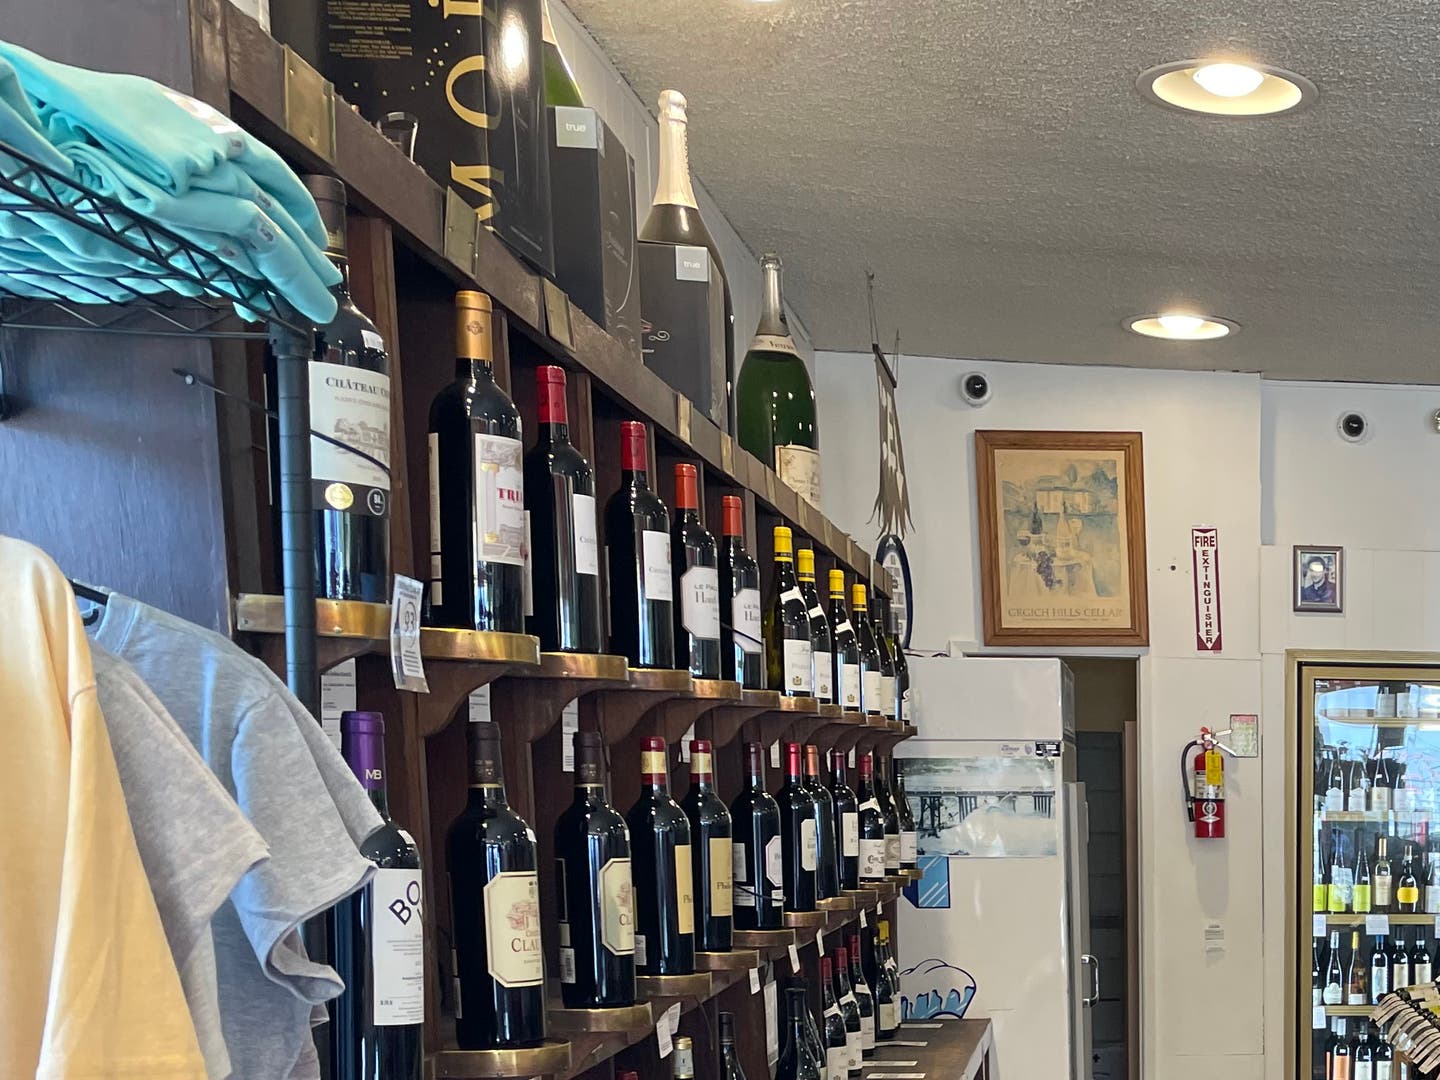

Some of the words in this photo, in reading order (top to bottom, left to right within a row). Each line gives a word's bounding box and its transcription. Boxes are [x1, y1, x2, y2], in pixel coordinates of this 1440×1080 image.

[566, 122, 586, 132] true
[684, 261, 701, 269] true
[1194, 536, 1215, 548] FIRE
[1202, 550, 1213, 644] EXTINGUISHER
[1052, 608, 1080, 618] HILLS
[365, 769, 382, 780] MB
